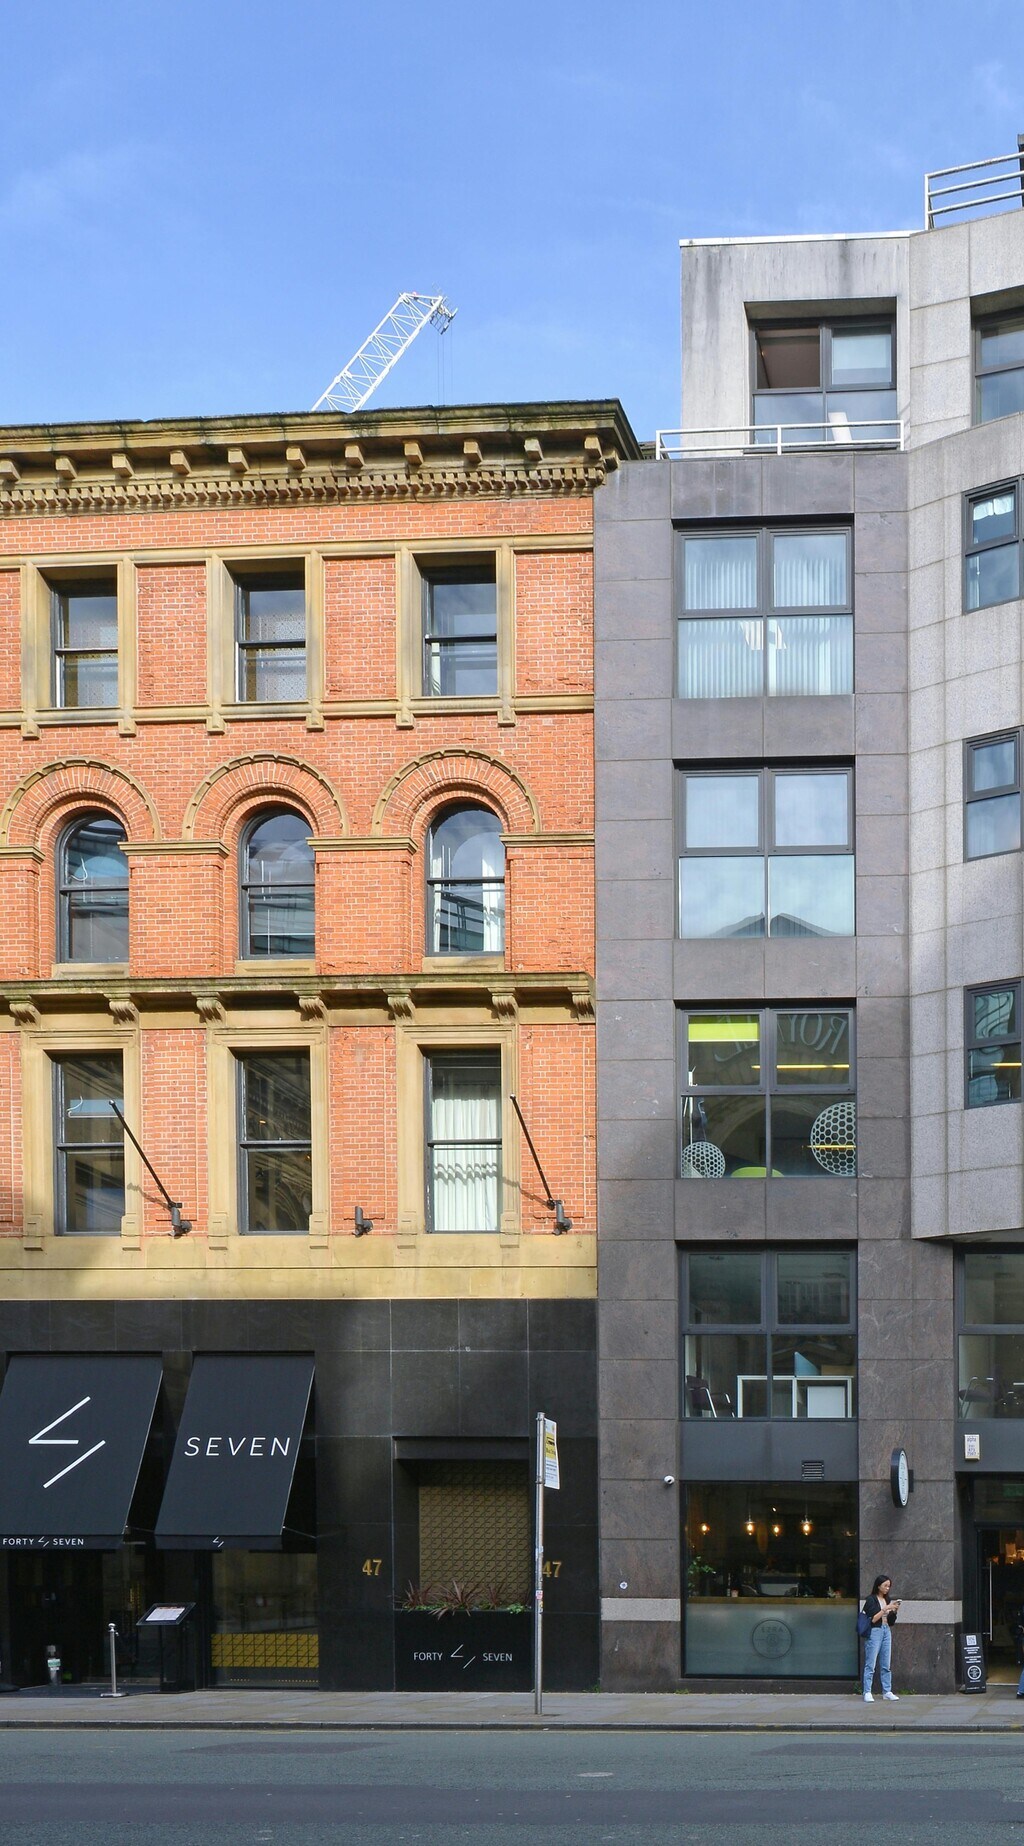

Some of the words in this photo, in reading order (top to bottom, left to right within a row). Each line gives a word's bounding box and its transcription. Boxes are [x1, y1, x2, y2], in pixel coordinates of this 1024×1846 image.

[184, 1436, 290, 1456] SEVEN
[2, 1538, 35, 1546] FORTY
[52, 1538, 84, 1546] SEVEN
[362, 1559, 382, 1576] 47
[542, 1560, 561, 1577] 47
[413, 1651, 443, 1661] FORTY
[482, 1652, 513, 1662] SEVEN
